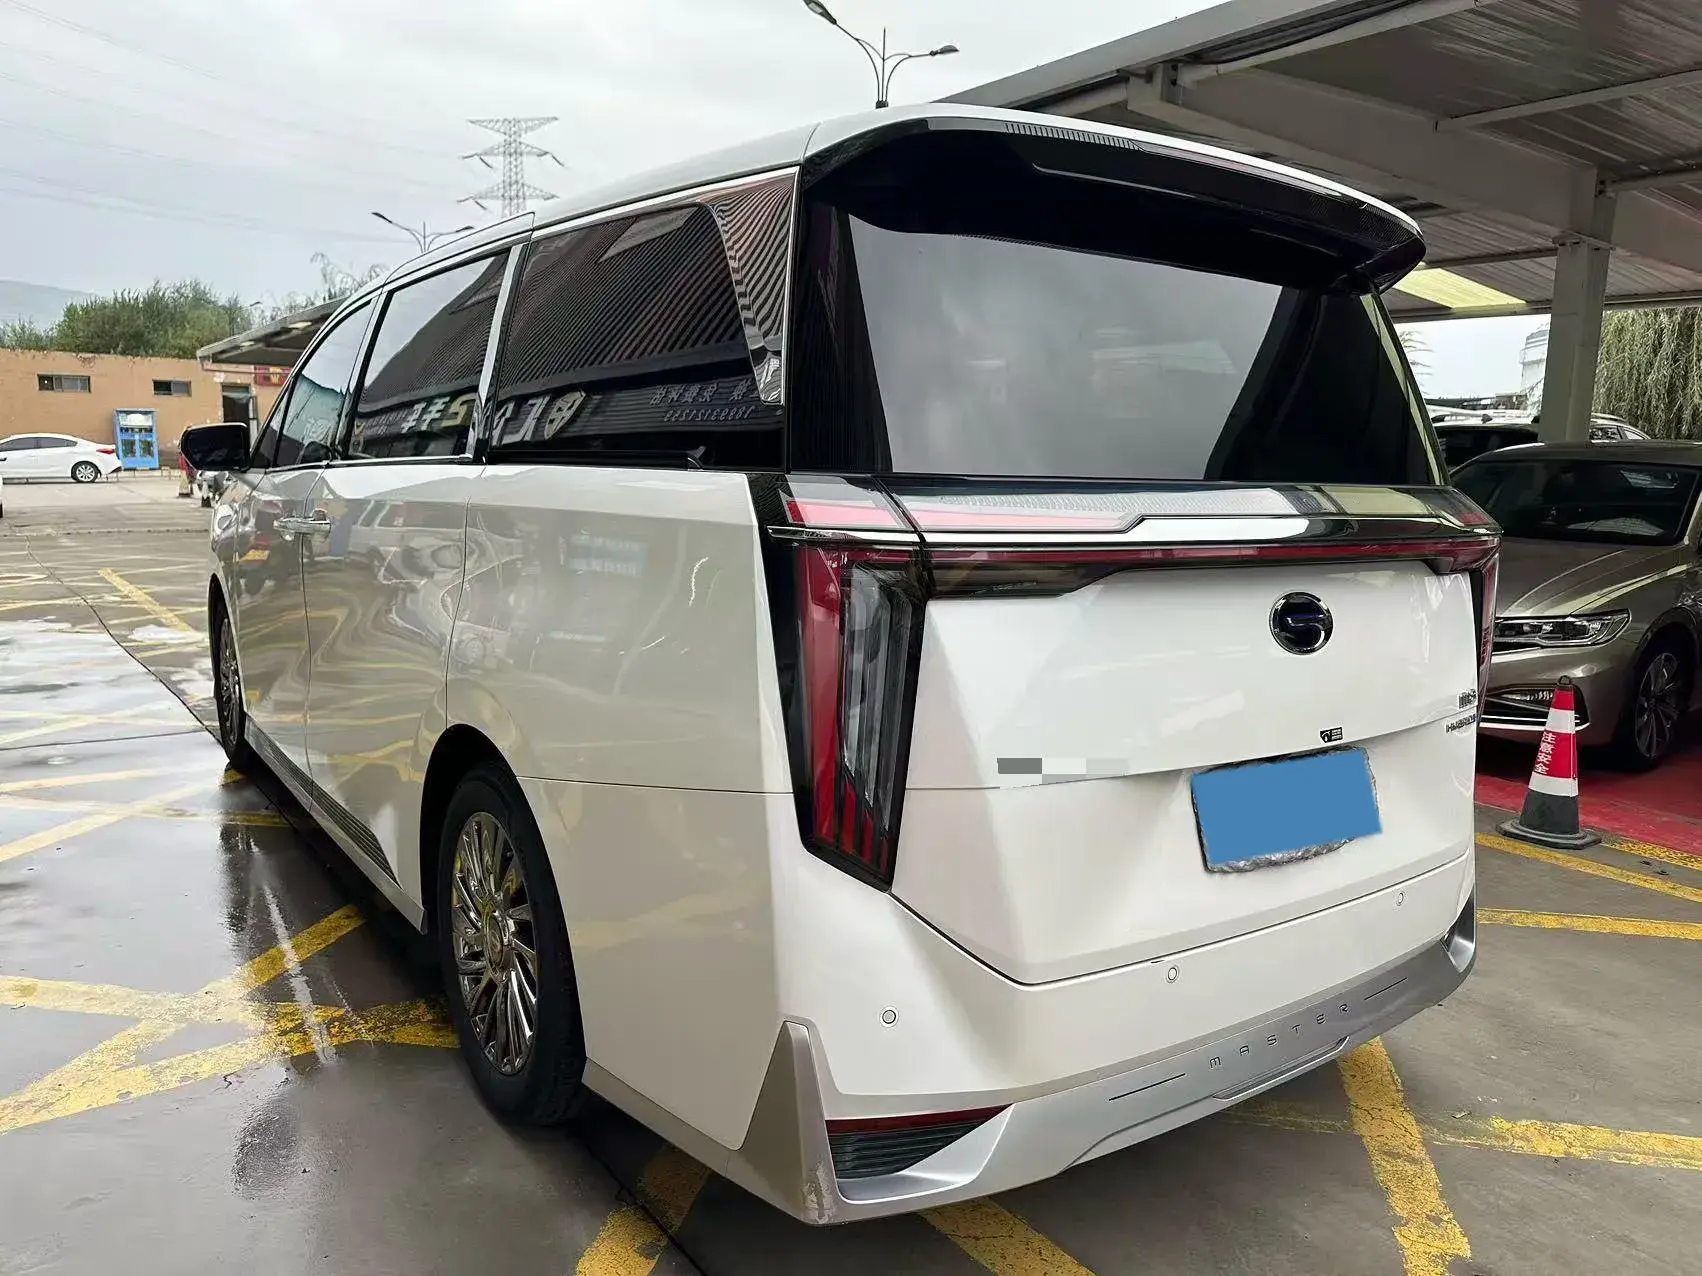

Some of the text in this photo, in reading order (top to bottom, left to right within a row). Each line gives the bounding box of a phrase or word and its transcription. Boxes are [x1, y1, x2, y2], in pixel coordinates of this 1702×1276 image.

[1534, 731, 1556, 775] 注意安全
[1209, 1003, 1350, 1069] MASTER
